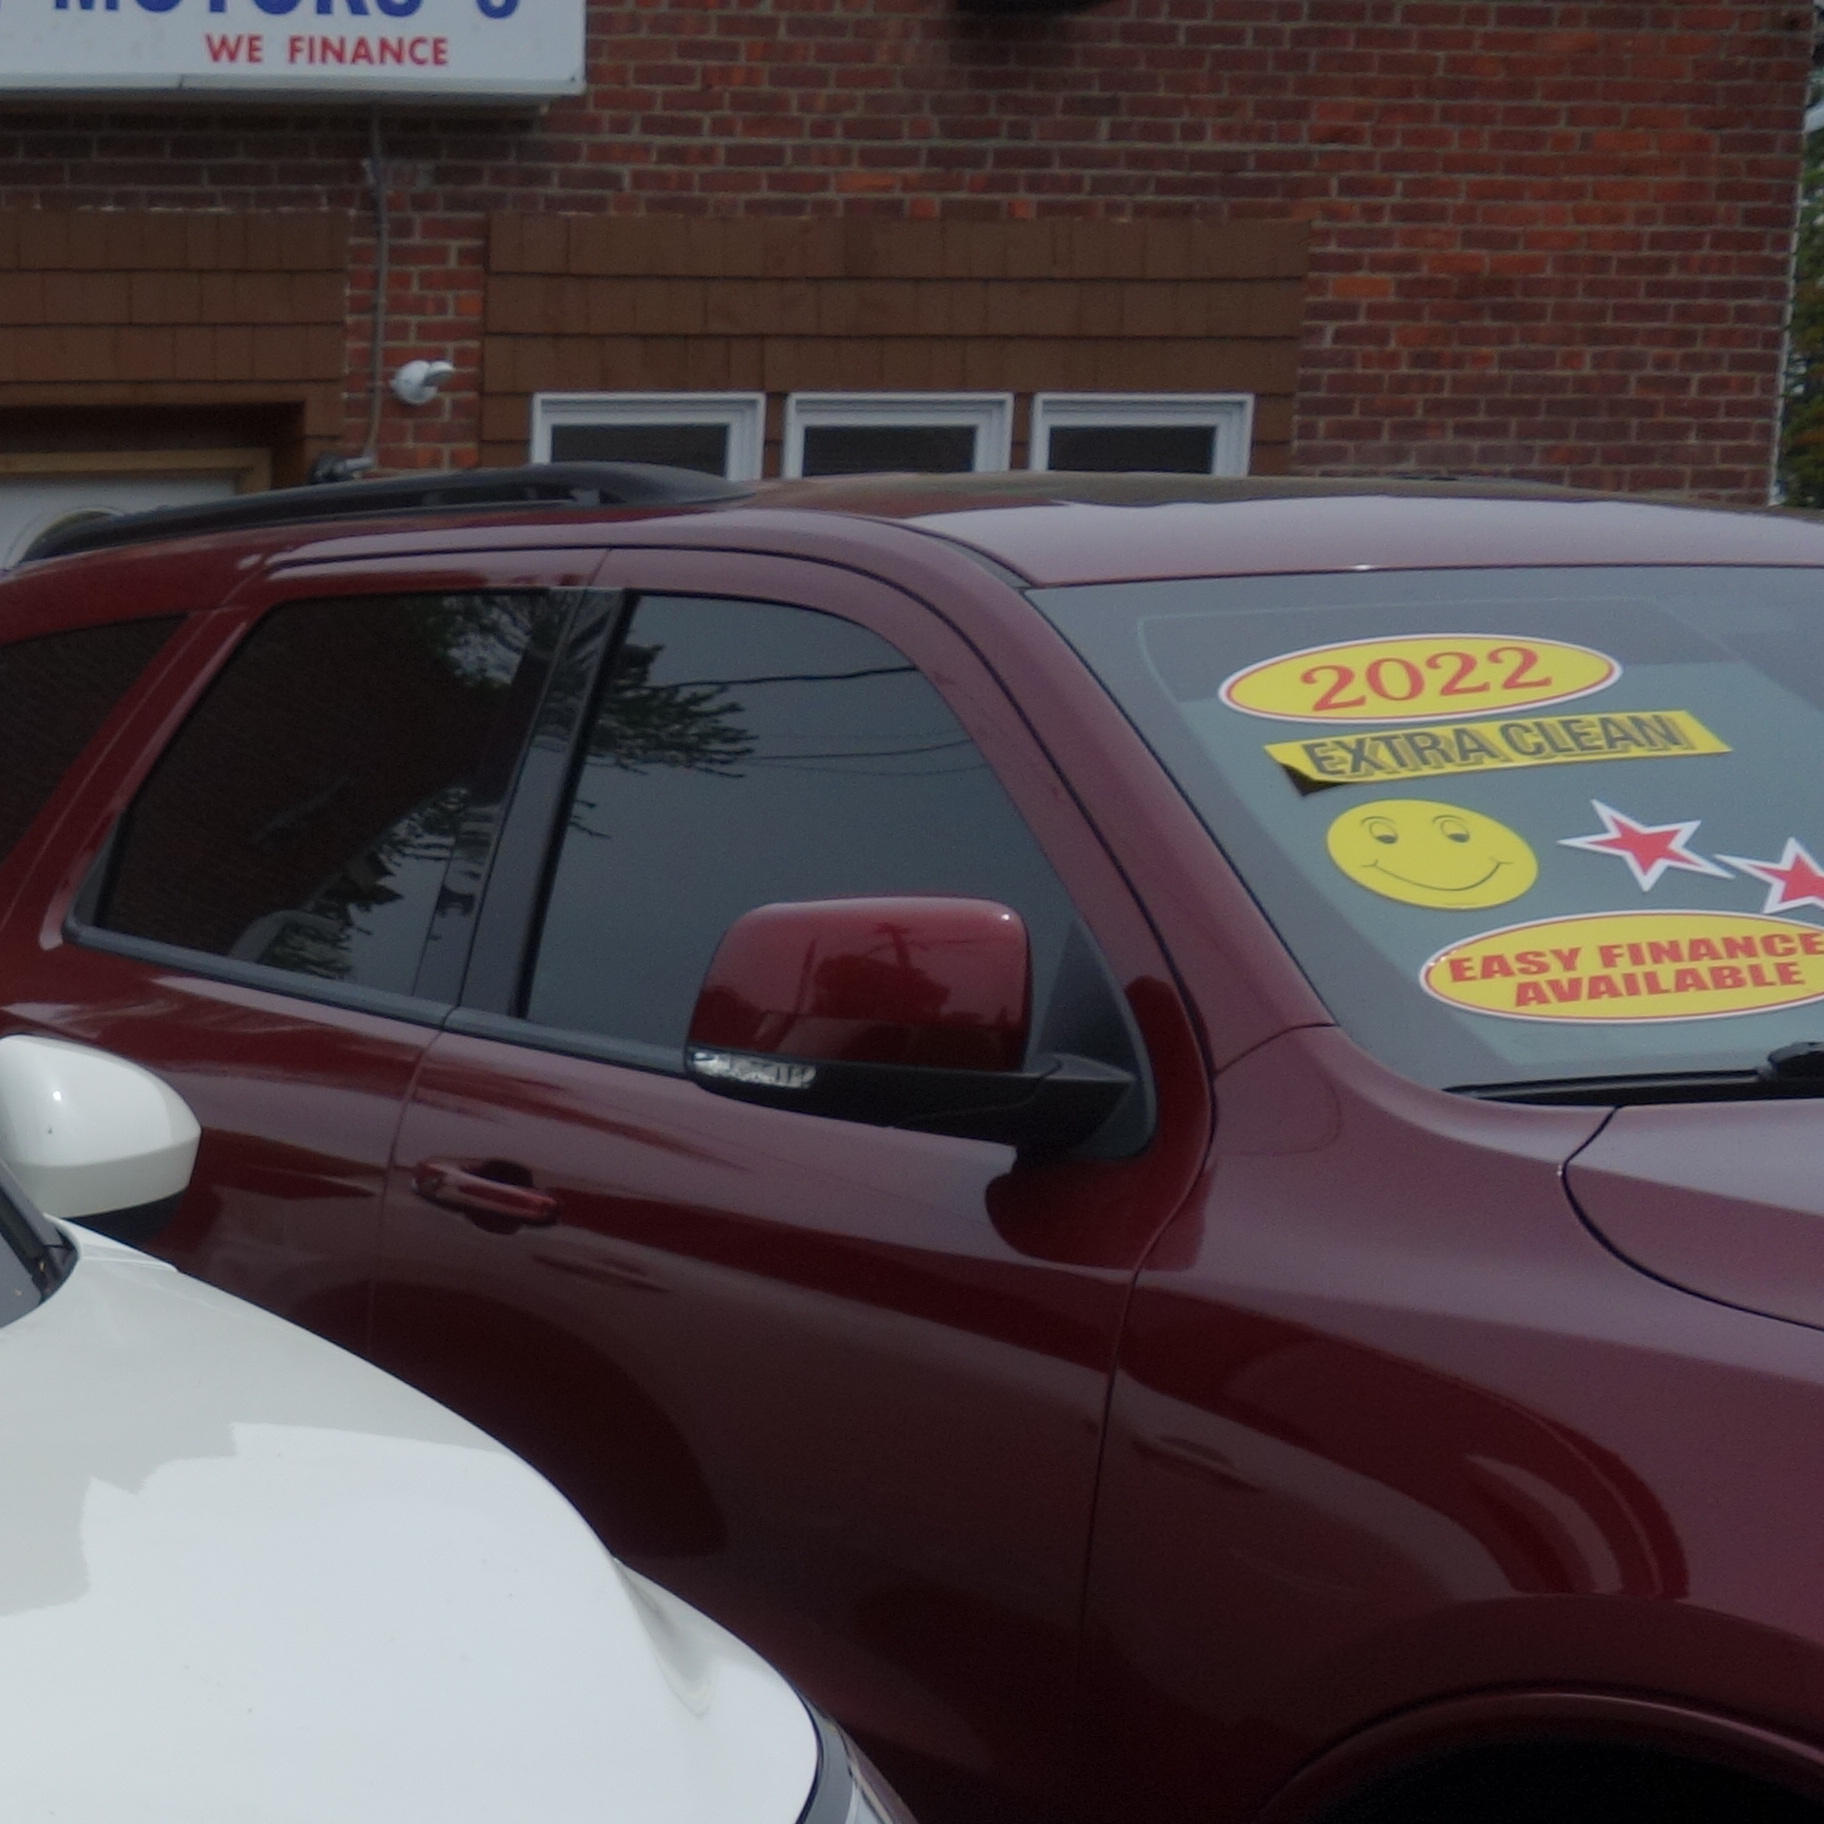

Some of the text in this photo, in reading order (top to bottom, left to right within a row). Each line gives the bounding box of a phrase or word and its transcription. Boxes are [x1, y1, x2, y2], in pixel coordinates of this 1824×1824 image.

[204, 33, 449, 66] WE FINANCE
[1299, 645, 1553, 712] 2022
[1301, 712, 1693, 779] EXTRA CLEAN
[1450, 932, 1824, 983] EASY FINANCE
[1514, 961, 1806, 1007] AVAILABLE
